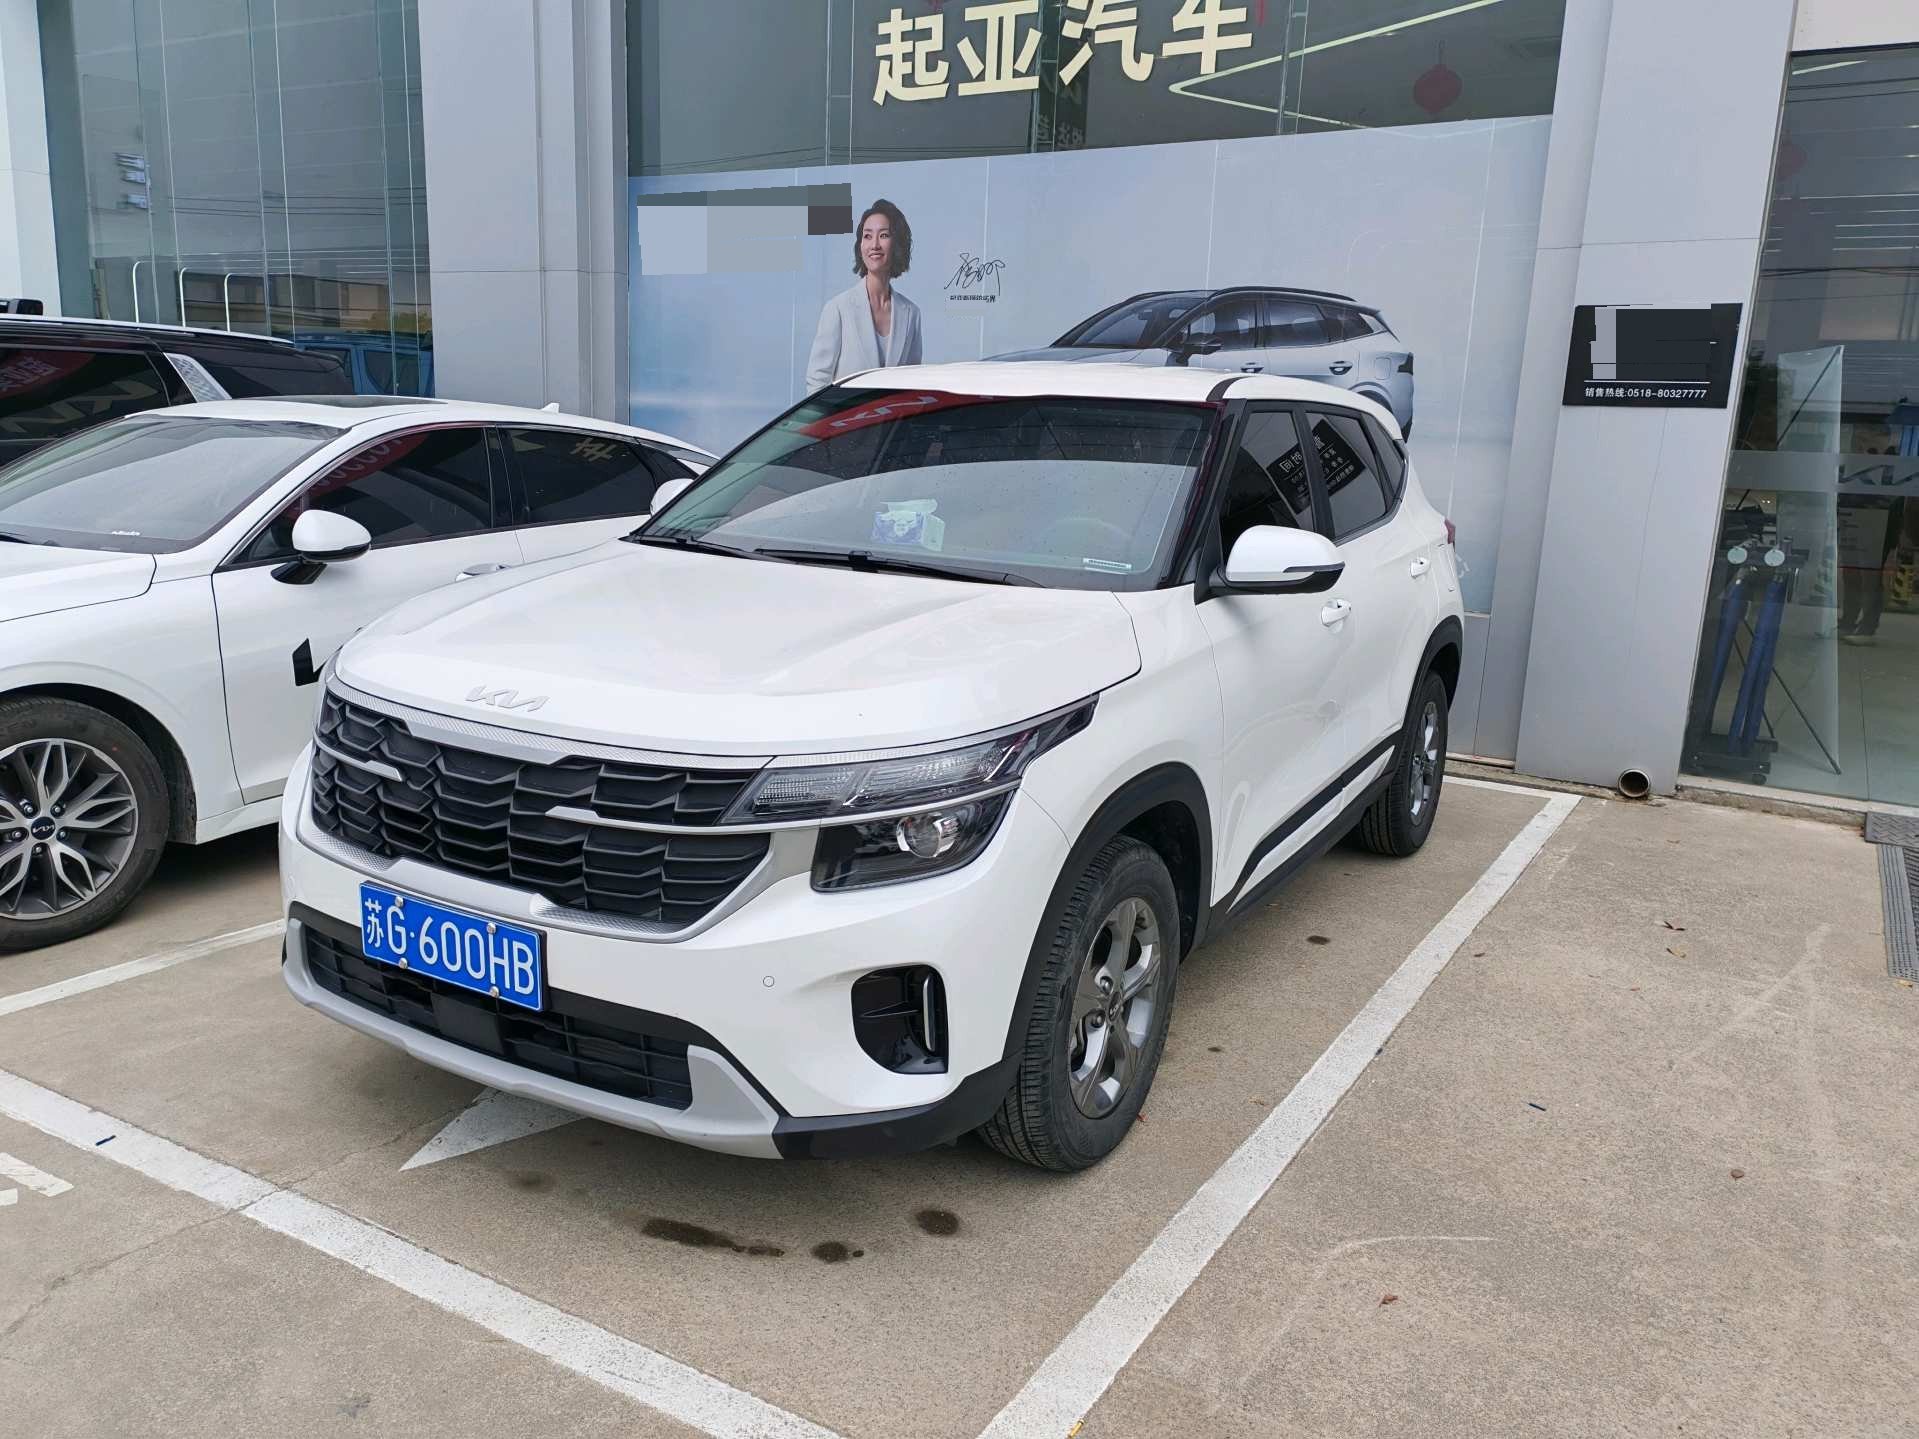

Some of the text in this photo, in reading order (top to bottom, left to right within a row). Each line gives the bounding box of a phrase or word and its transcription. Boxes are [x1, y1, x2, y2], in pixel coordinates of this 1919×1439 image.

[873, 0, 1252, 105] 起亚汽车
[465, 686, 549, 712] KIA
